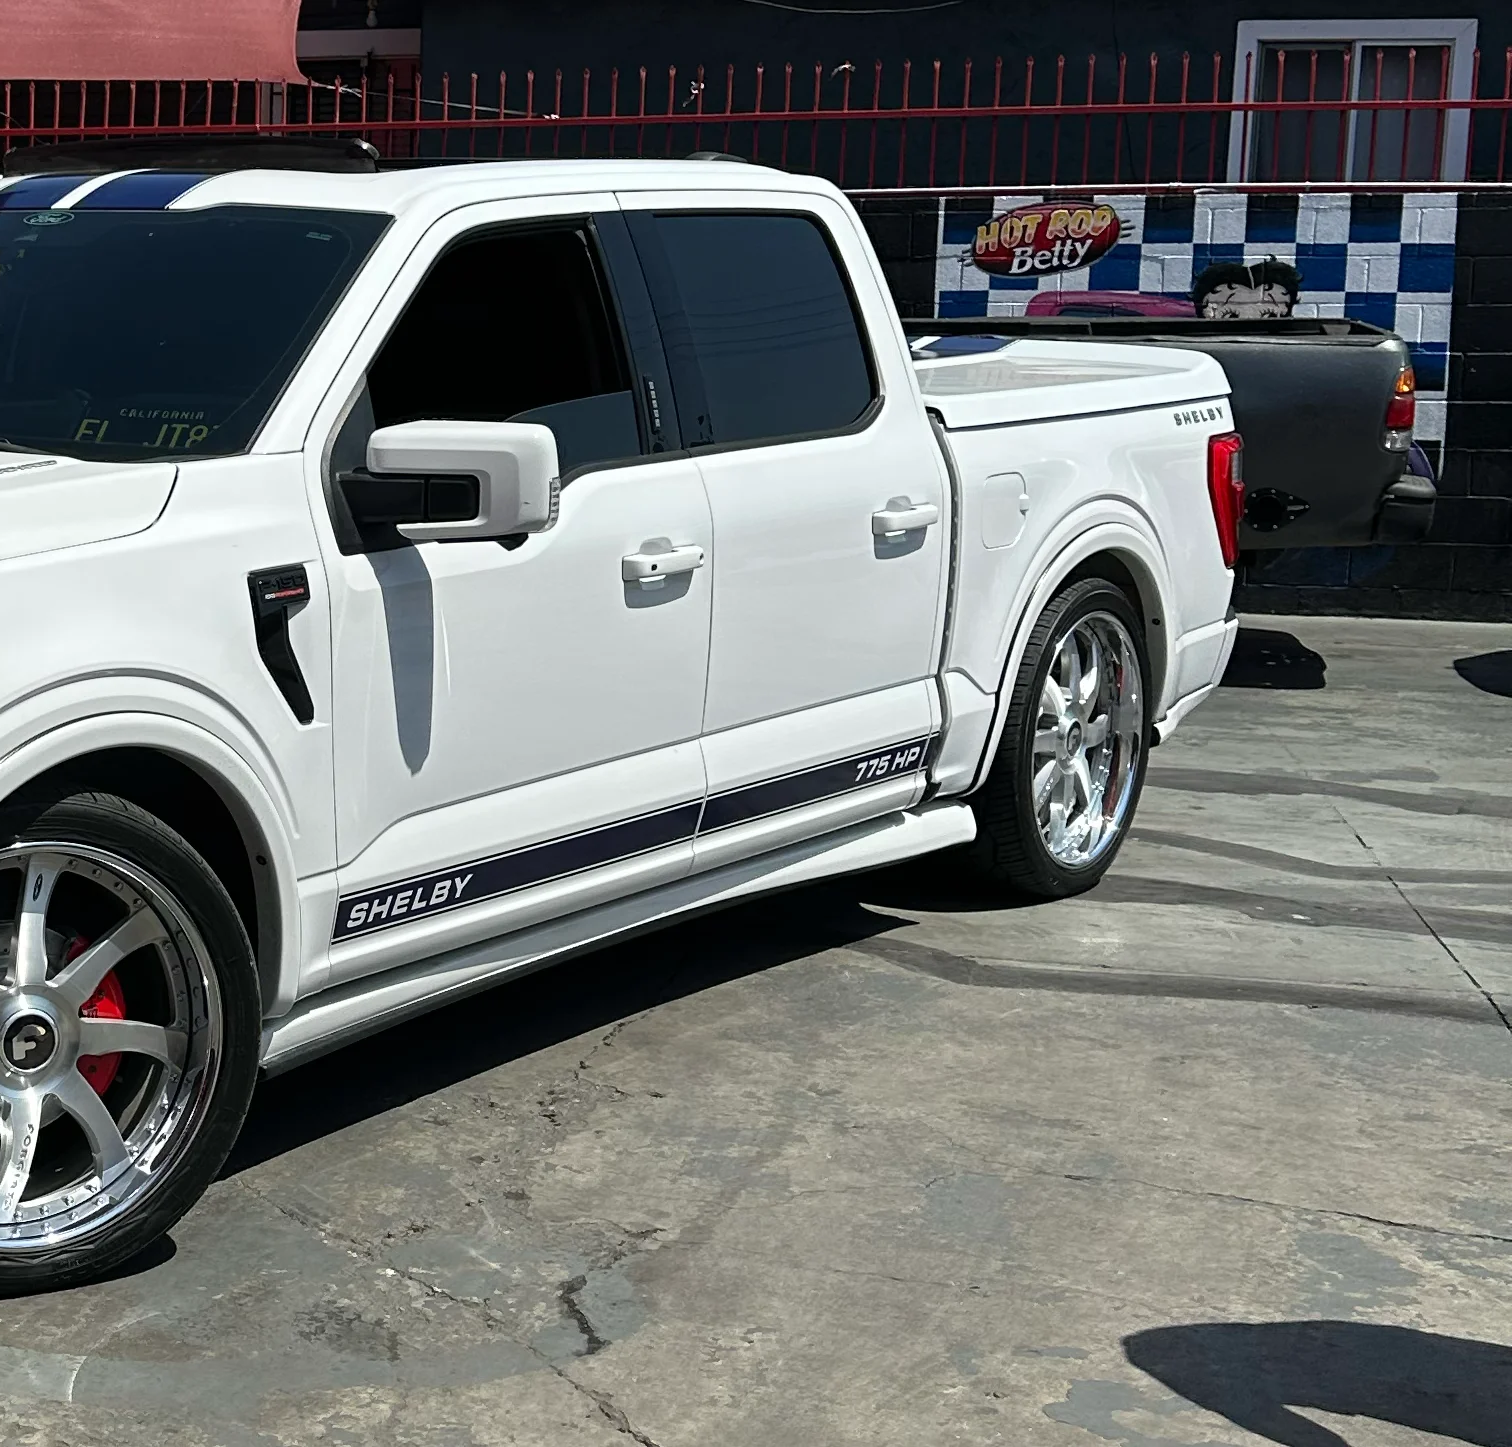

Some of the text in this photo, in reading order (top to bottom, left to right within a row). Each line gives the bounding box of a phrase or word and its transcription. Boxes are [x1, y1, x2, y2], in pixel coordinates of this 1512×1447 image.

[975, 205, 1115, 255] HOT ROD
[1009, 239, 1093, 274] Betty
[120, 408, 205, 420] CALIFORNIA
[1173, 406, 1223, 427] SHELBY
[855, 746, 921, 782] 775 HP
[346, 873, 474, 928] SHELBY
